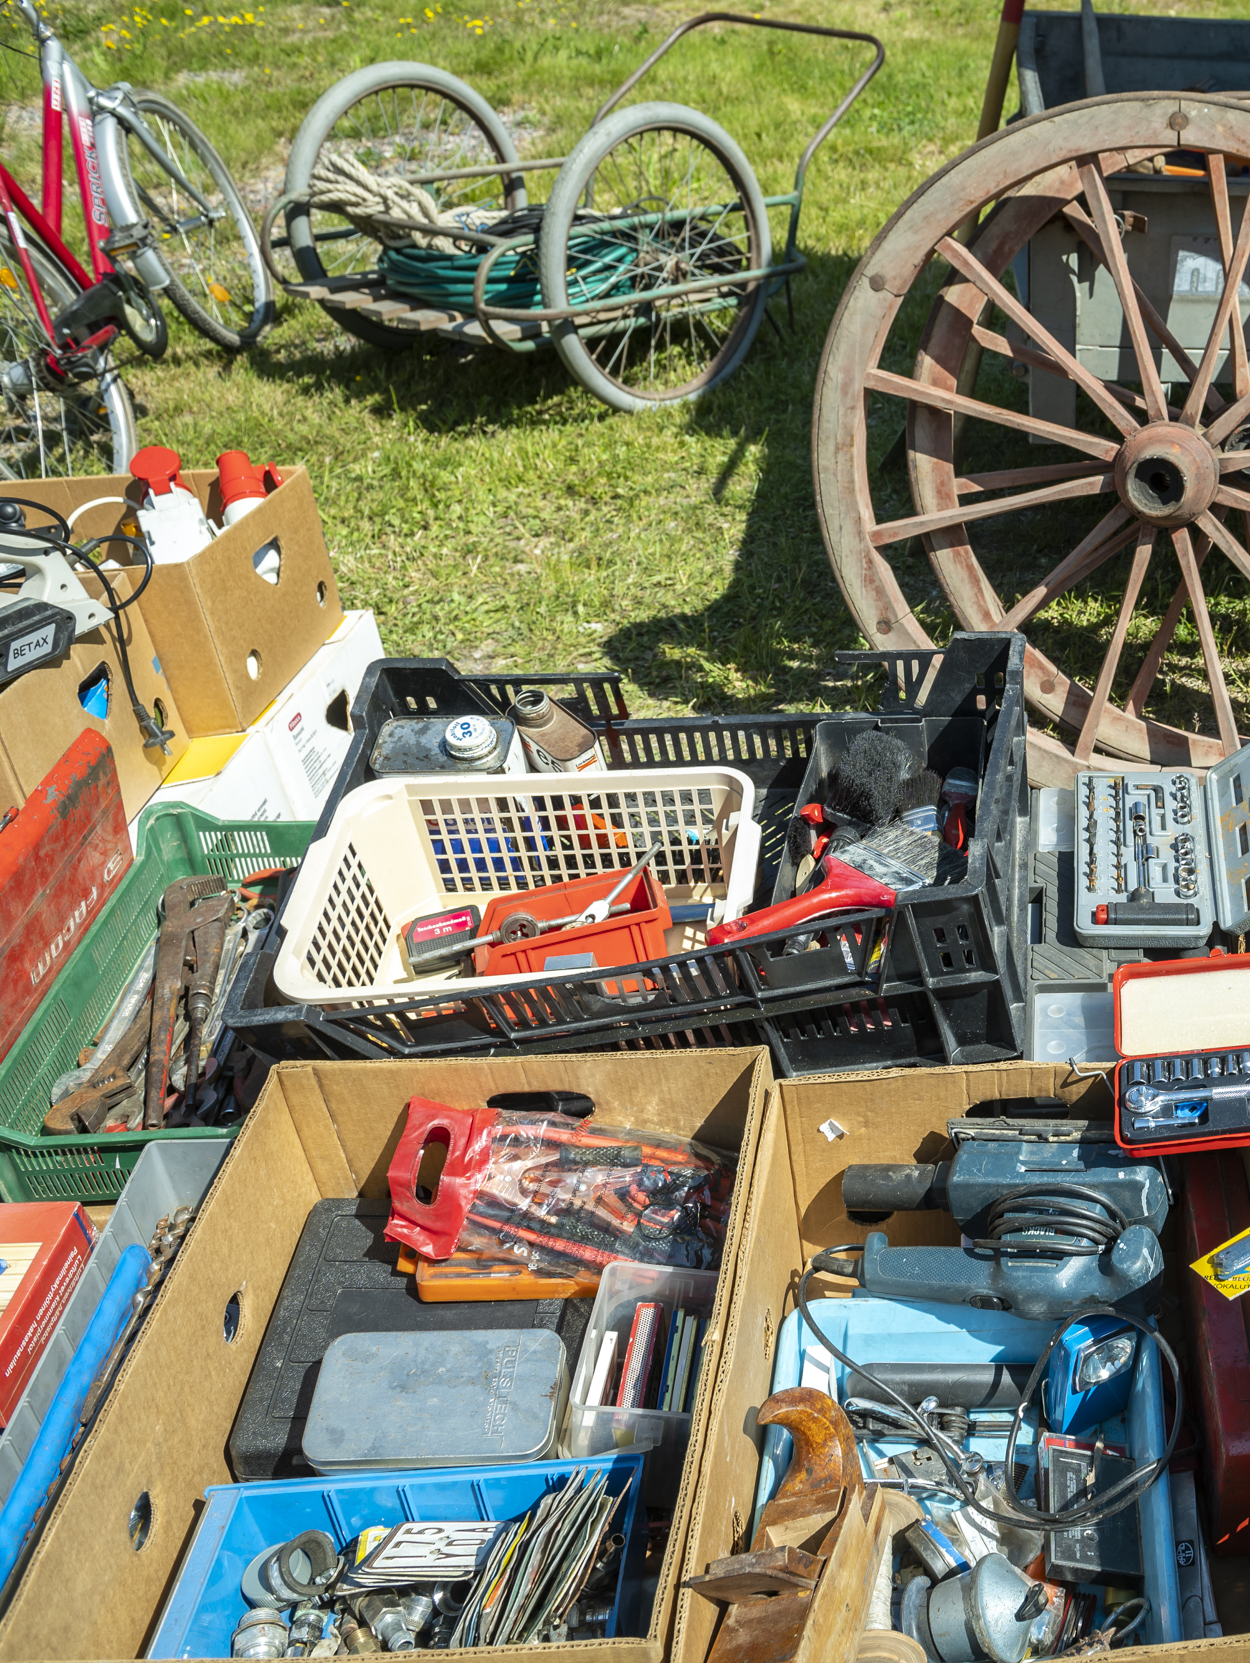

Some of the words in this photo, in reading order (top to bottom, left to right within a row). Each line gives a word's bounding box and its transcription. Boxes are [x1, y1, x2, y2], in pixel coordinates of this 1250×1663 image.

[83, 146, 109, 227] SPRICK
[13, 634, 49, 660] BETAX
[459, 721, 473, 739] 30
[30, 884, 97, 985] FACOM
[4, 1320, 38, 1378] hakasnaulain
[382, 1526, 446, 1561] 175
[434, 1526, 497, 1562] YDA
